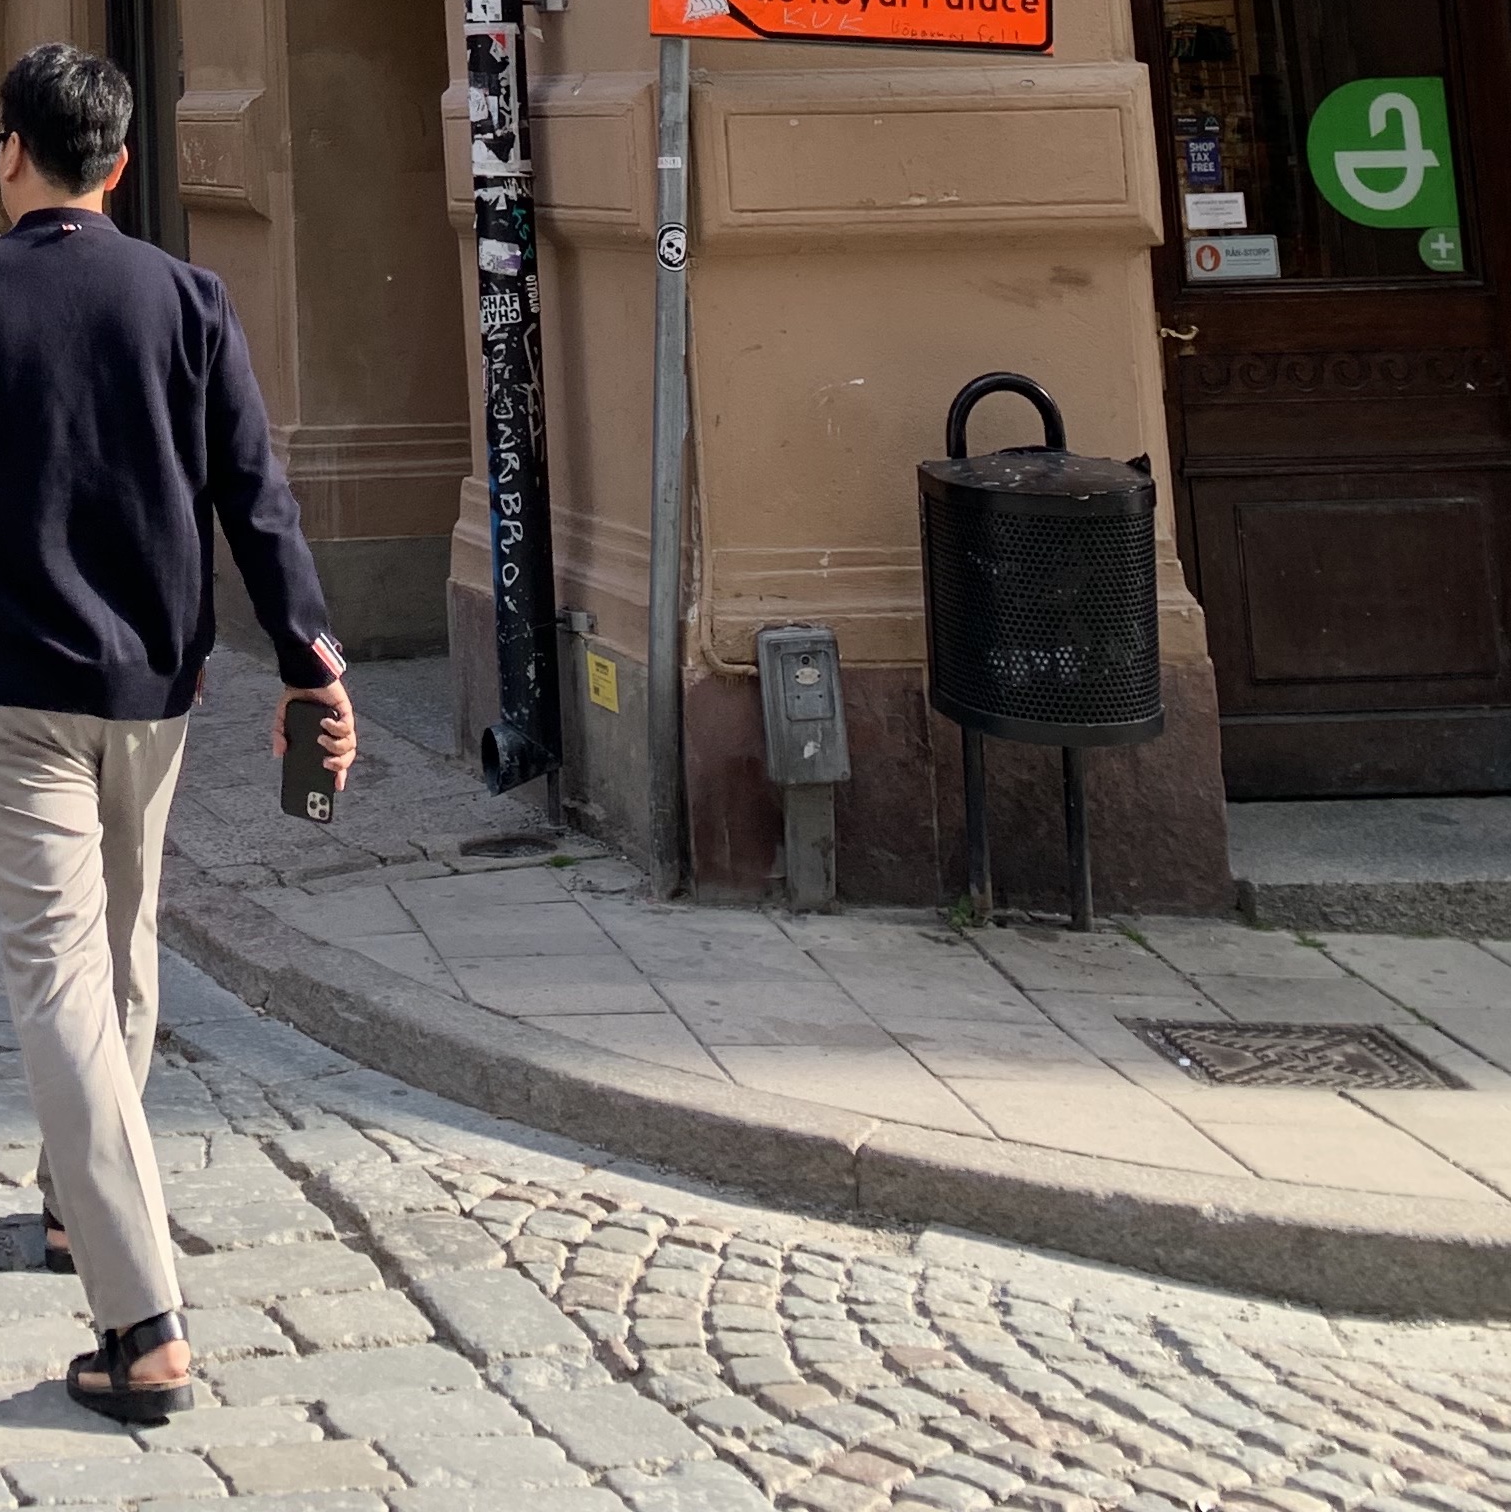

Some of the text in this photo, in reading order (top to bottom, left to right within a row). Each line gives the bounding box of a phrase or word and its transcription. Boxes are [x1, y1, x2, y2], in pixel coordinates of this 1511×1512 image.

[1189, 143, 1215, 152] SHOP
[1191, 153, 1210, 161] TAX
[1192, 162, 1216, 172] FREE
[481, 295, 518, 309] CHAF
